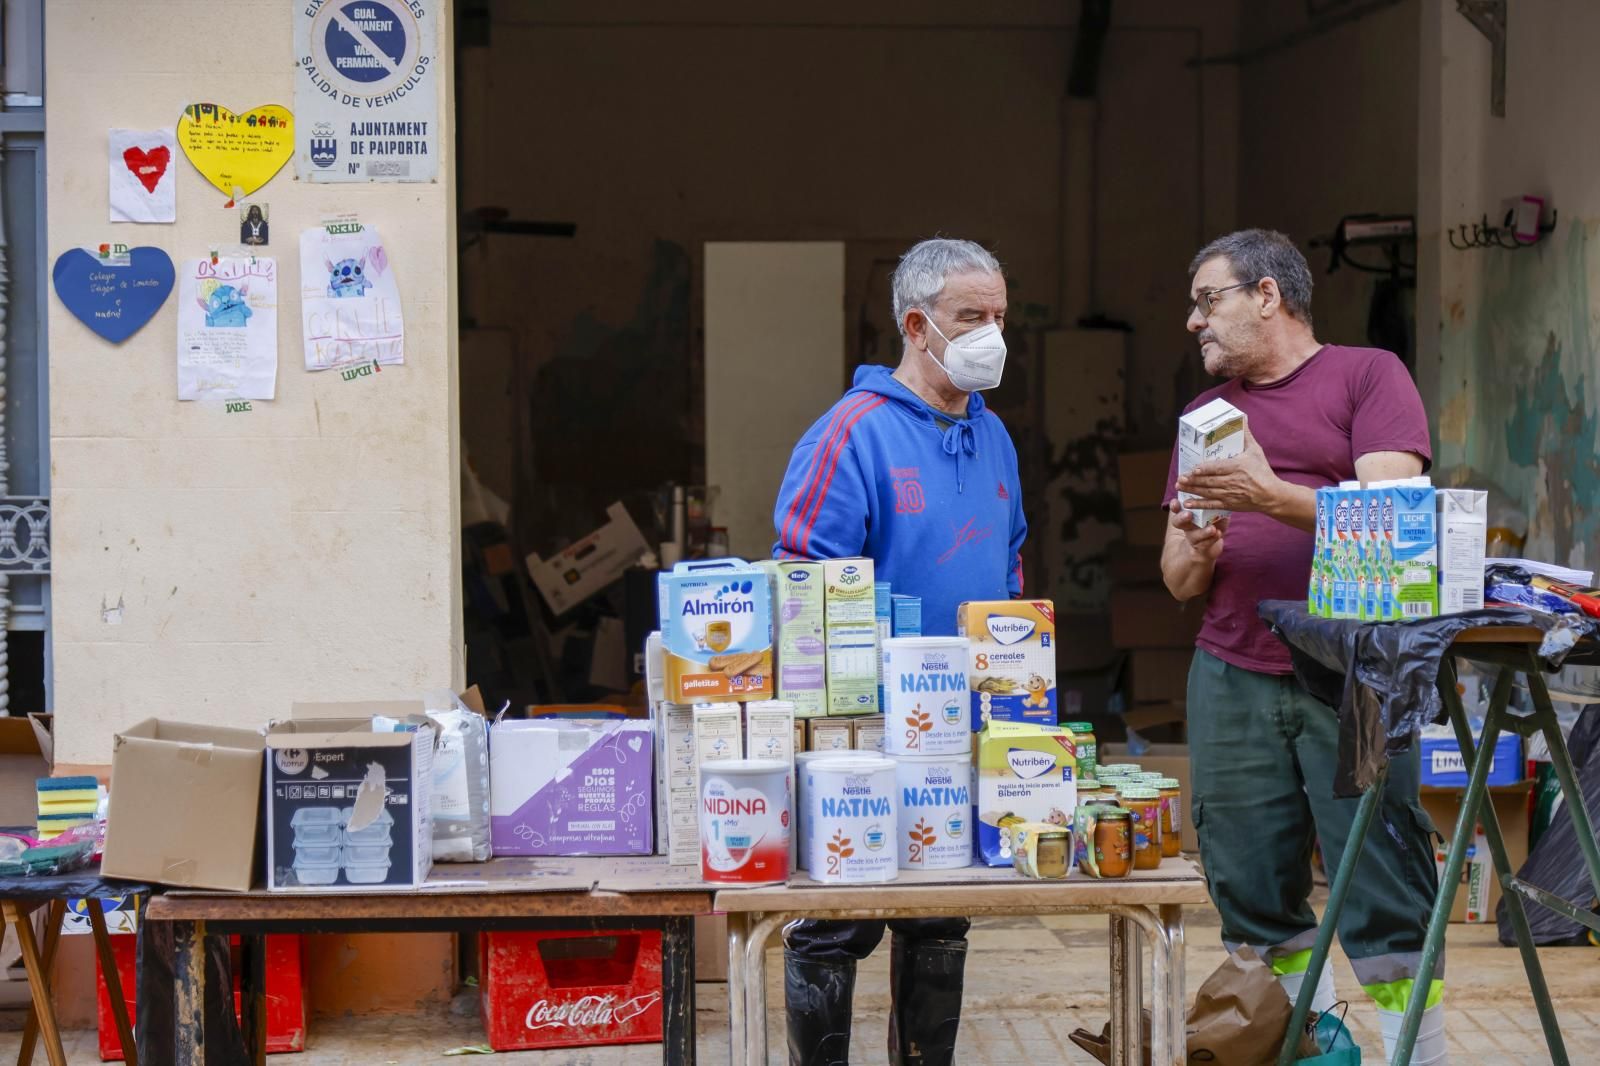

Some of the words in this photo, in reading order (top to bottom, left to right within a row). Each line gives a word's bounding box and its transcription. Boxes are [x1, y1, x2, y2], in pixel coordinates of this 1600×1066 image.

[354, 8, 376, 19] GUAL
[302, 56, 338, 101] SALIDA
[341, 94, 361, 108] DE
[366, 56, 430, 109] VEHICULOS
[350, 122, 428, 136] AJUNTAMENT
[350, 141, 366, 155] DE
[369, 141, 428, 155] PAIPORTA
[893, 480, 926, 514] 10
[682, 598, 754, 616] Almirón
[991, 624, 1029, 633] Nutribén
[921, 662, 949, 671] Nestlé
[975, 653, 989, 670] 8
[990, 652, 1026, 660] cereales
[683, 678, 720, 690] galletitas
[900, 672, 966, 693] NATIVA
[905, 729, 919, 749] 2
[281, 755, 304, 767] home
[315, 752, 344, 762] Expert
[1012, 756, 1050, 767] Nutribén
[925, 776, 953, 785] Nestlé
[842, 787, 872, 796] Nestlé
[903, 786, 969, 807] NATIVA
[998, 787, 1031, 798] Biberón
[577, 804, 616, 812] REGLAS
[704, 798, 766, 816] NIDINA
[821, 797, 891, 818] NATIVA
[711, 820, 720, 841] 1
[549, 833, 582, 845] compresas
[583, 832, 616, 845] ultrafinas
[908, 843, 922, 863] 2
[826, 855, 840, 876] 2
